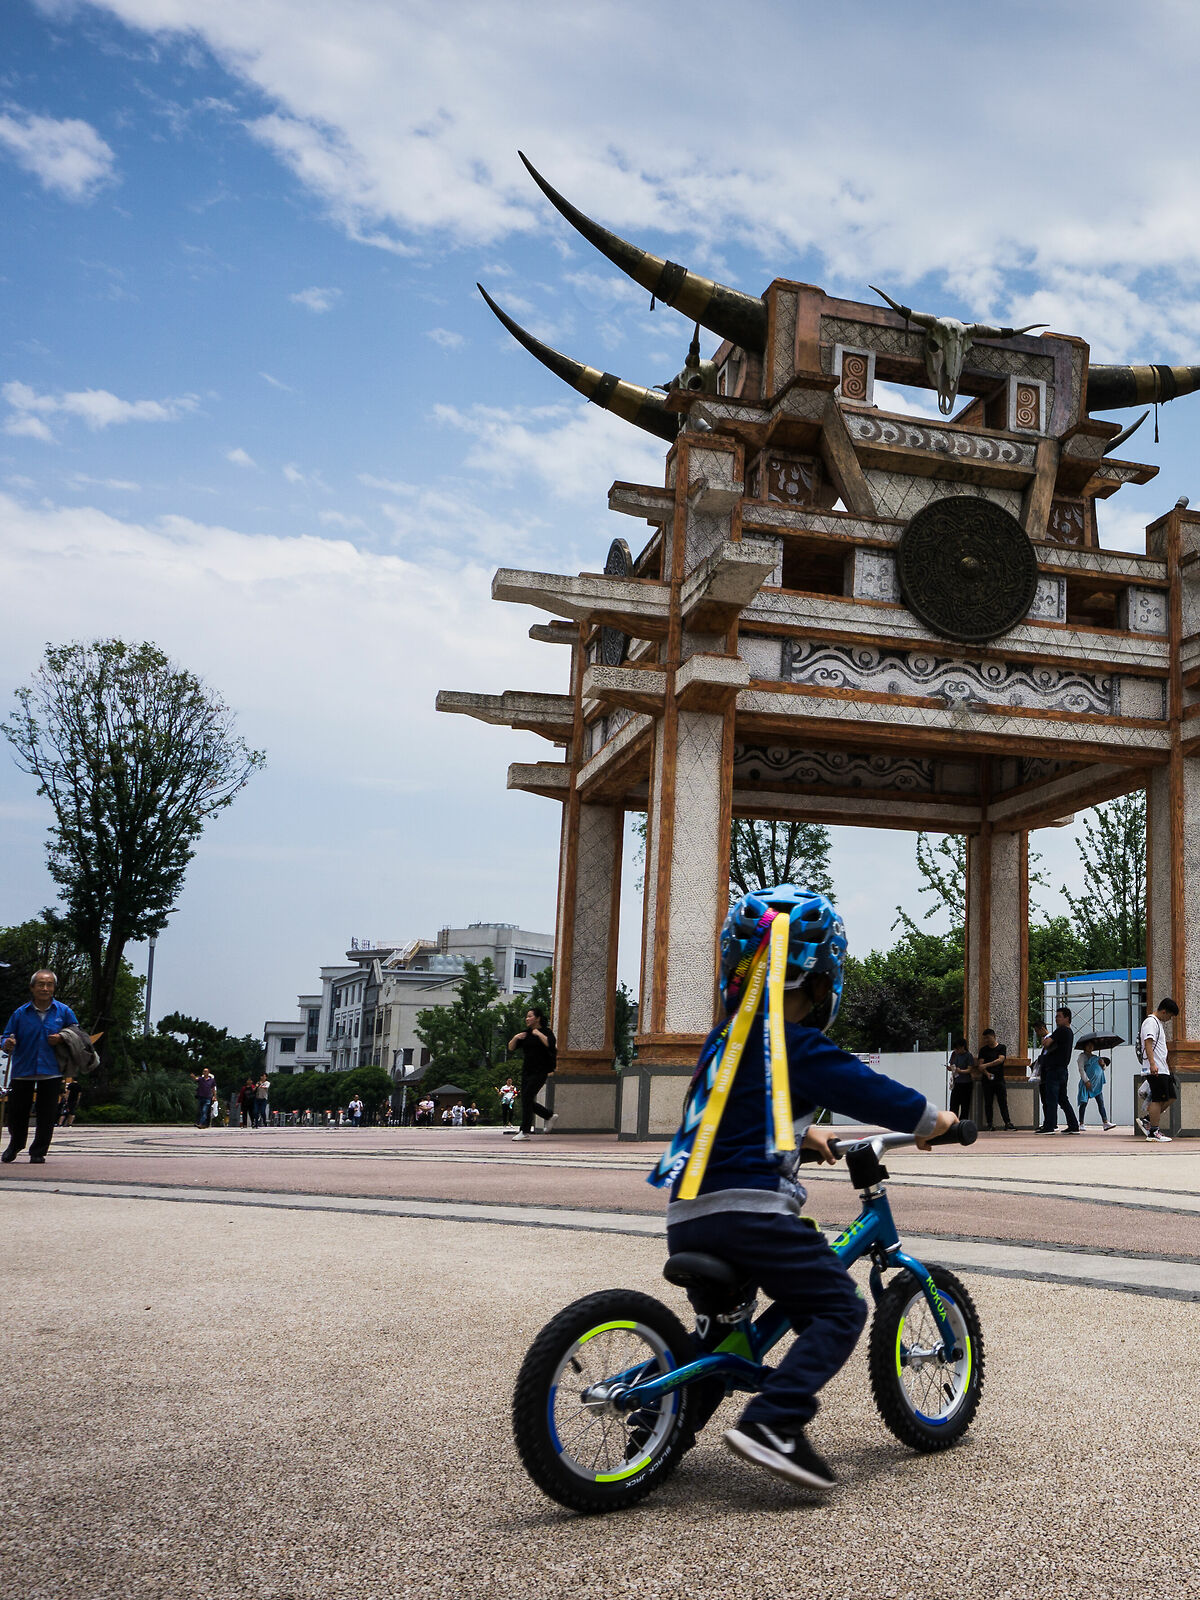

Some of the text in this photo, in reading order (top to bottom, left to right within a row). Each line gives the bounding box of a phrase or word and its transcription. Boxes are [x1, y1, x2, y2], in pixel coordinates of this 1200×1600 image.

[743, 960, 768, 1013] Supreme
[716, 1041, 743, 1093] Supreme
[690, 1123, 715, 1177] Supreme
[926, 1275, 947, 1322] KOKUA
[625, 1445, 672, 1489] BLACK JACK
